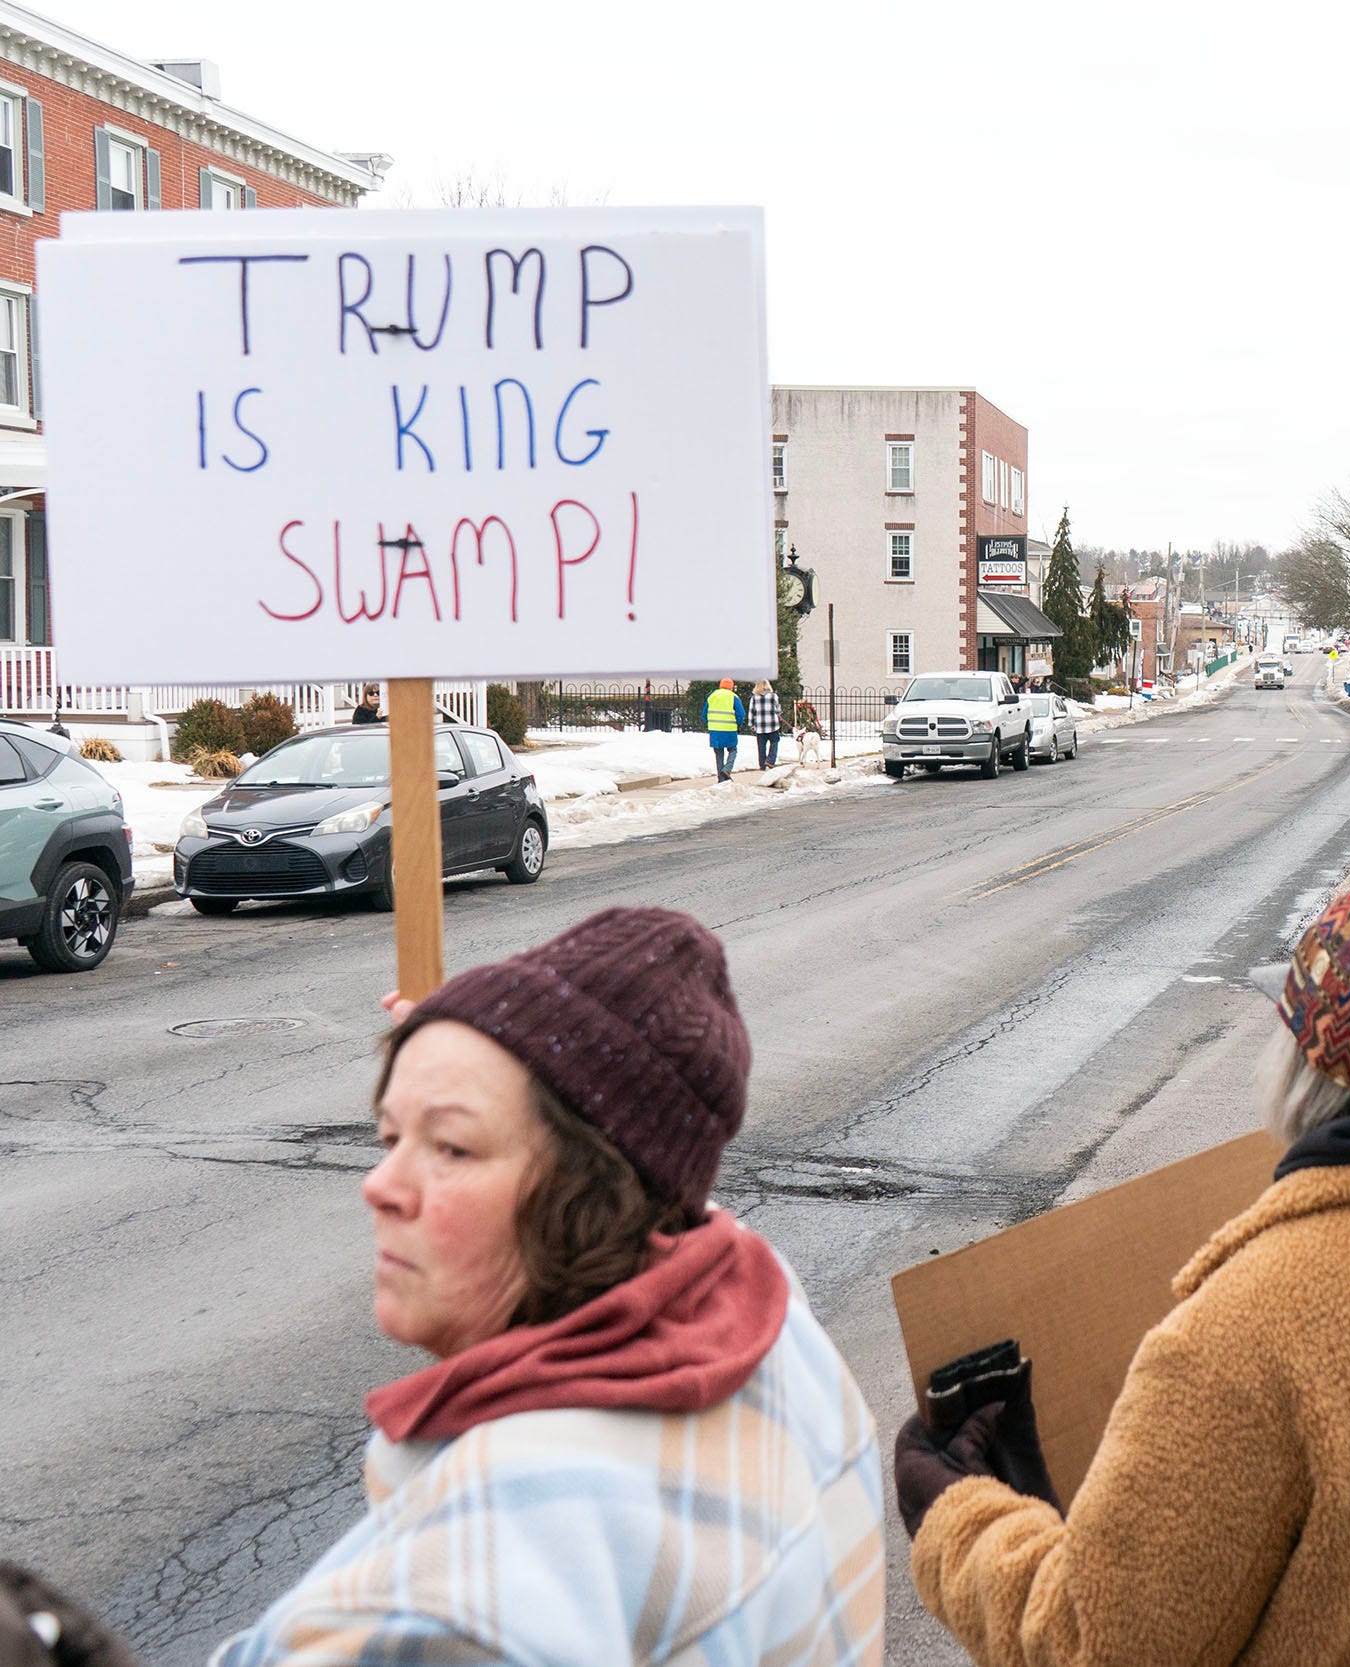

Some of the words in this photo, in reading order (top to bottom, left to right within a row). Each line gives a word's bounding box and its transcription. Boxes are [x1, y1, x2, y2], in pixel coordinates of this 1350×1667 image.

[178, 245, 635, 355] TRUMP
[197, 388, 270, 473] IS
[391, 379, 610, 473] KING
[258, 490, 640, 624] SWAMP!
[980, 562, 1024, 574] TATTOOS
